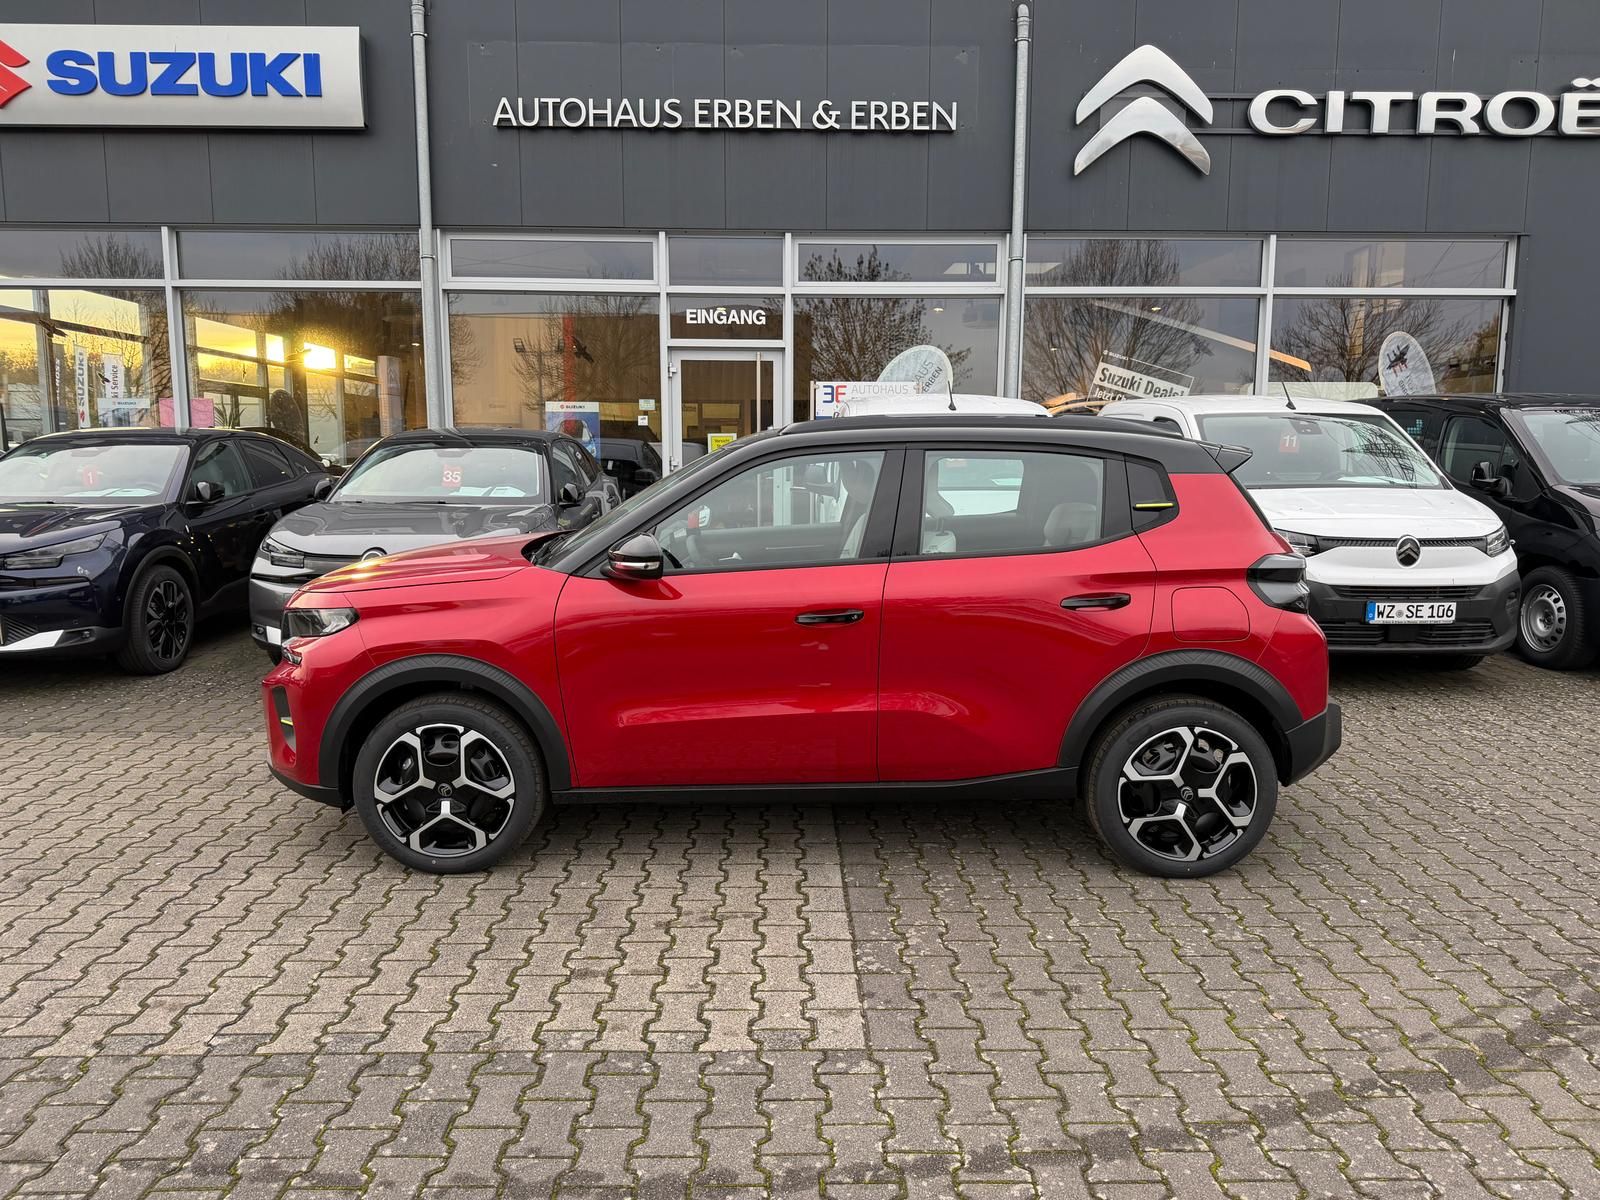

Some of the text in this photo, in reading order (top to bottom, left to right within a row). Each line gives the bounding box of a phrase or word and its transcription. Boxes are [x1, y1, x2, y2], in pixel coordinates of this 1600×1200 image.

[46, 50, 322, 97] SUZUKI
[493, 97, 958, 132] AUTOHAUS ERBEN & ERBEN
[686, 308, 766, 325] EINGANG
[77, 352, 85, 407] SUZUKI
[111, 364, 119, 391] Service
[851, 384, 909, 395] AUTOHAUS
[923, 366, 943, 393] ERBEN
[1099, 367, 1143, 393] Suzuki
[1283, 435, 1297, 447] 11
[443, 471, 461, 482] 35
[1376, 604, 1454, 619] WZ SE 106
